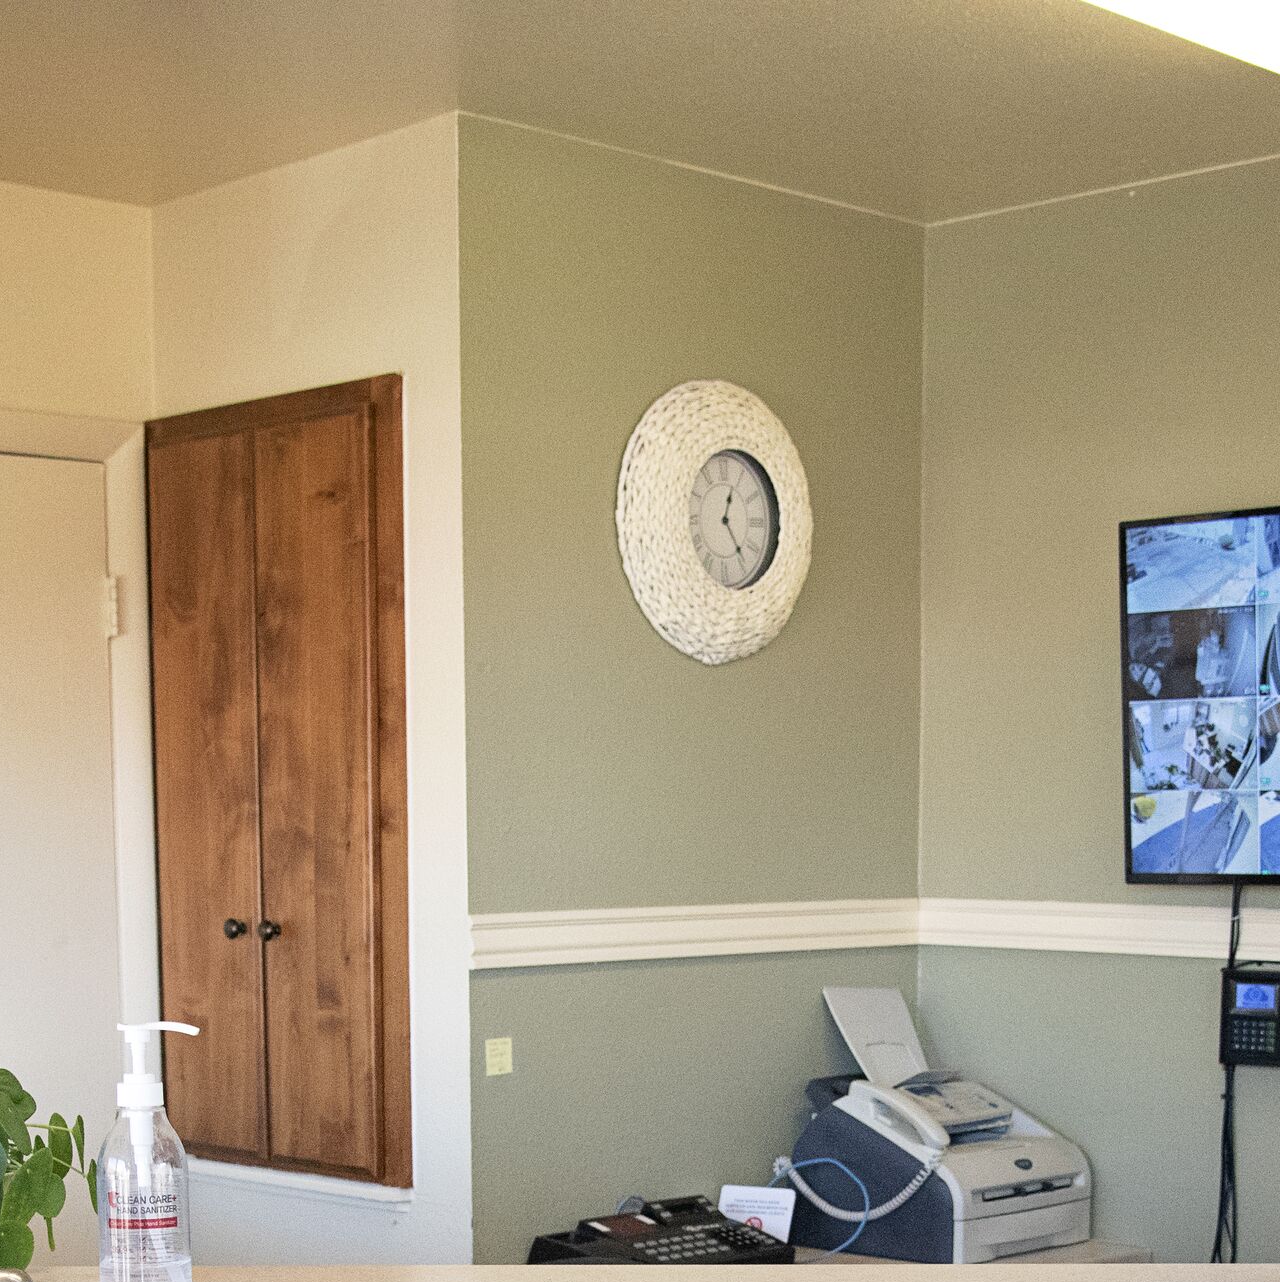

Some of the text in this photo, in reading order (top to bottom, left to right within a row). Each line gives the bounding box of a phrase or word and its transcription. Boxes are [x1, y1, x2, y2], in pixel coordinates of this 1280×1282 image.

[116, 1195, 147, 1205] CLEAN
[117, 1204, 178, 1215] HAND SANITIZER
